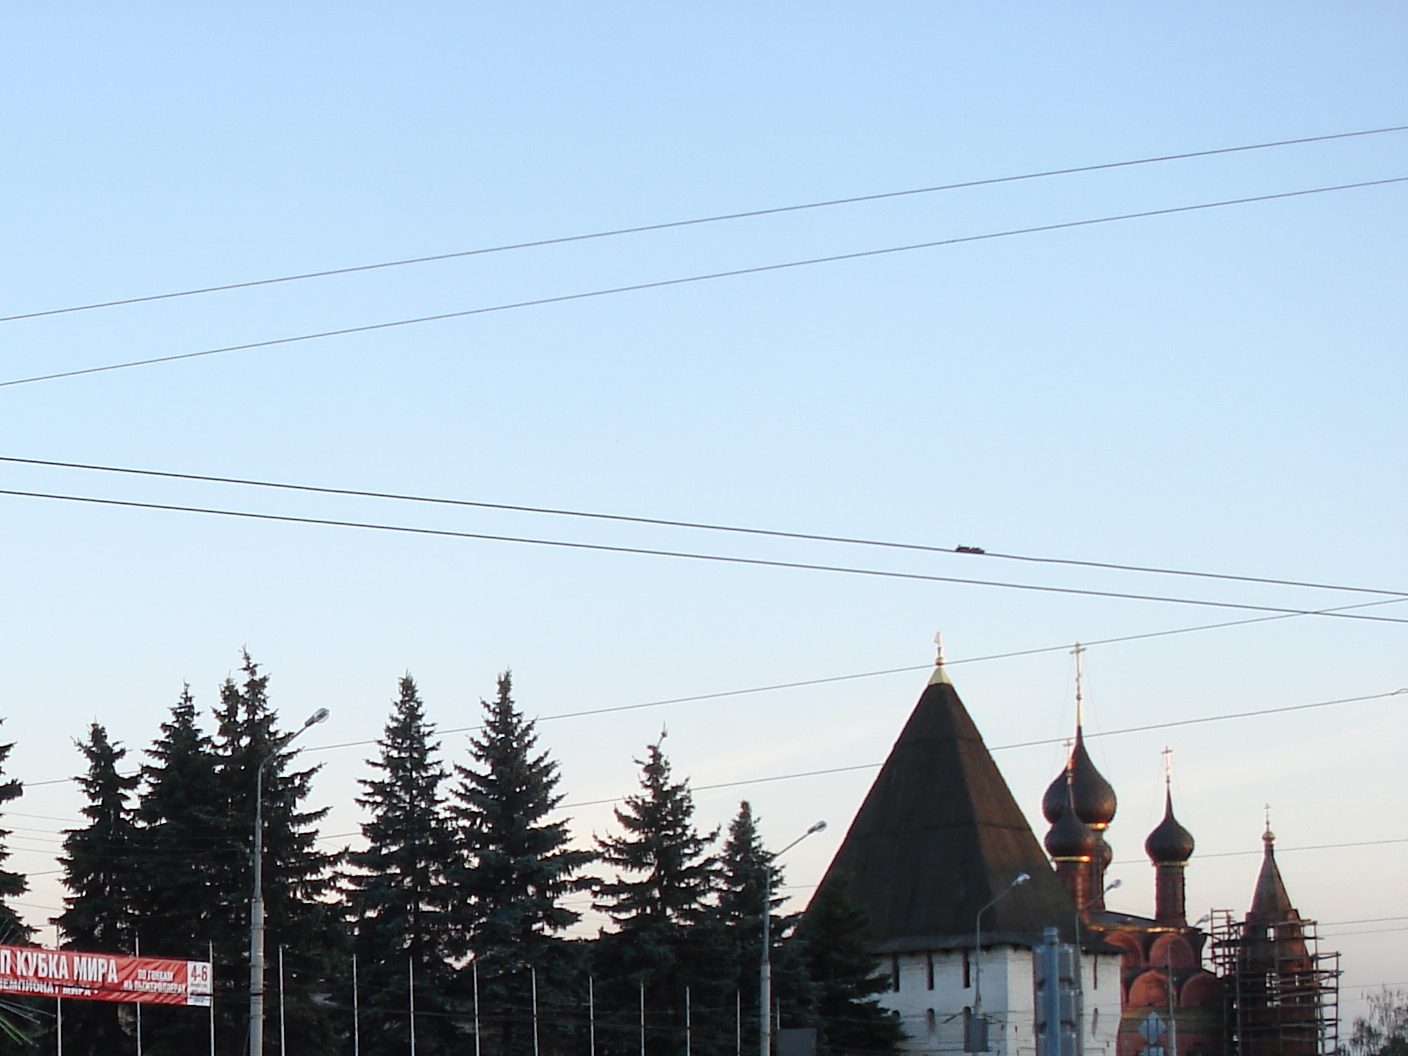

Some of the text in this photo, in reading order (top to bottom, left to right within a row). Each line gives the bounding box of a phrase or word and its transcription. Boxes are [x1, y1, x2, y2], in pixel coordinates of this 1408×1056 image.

[16, 950, 69, 980] КУБКА
[74, 956, 118, 983] МИРА
[191, 965, 207, 981] 4-6
